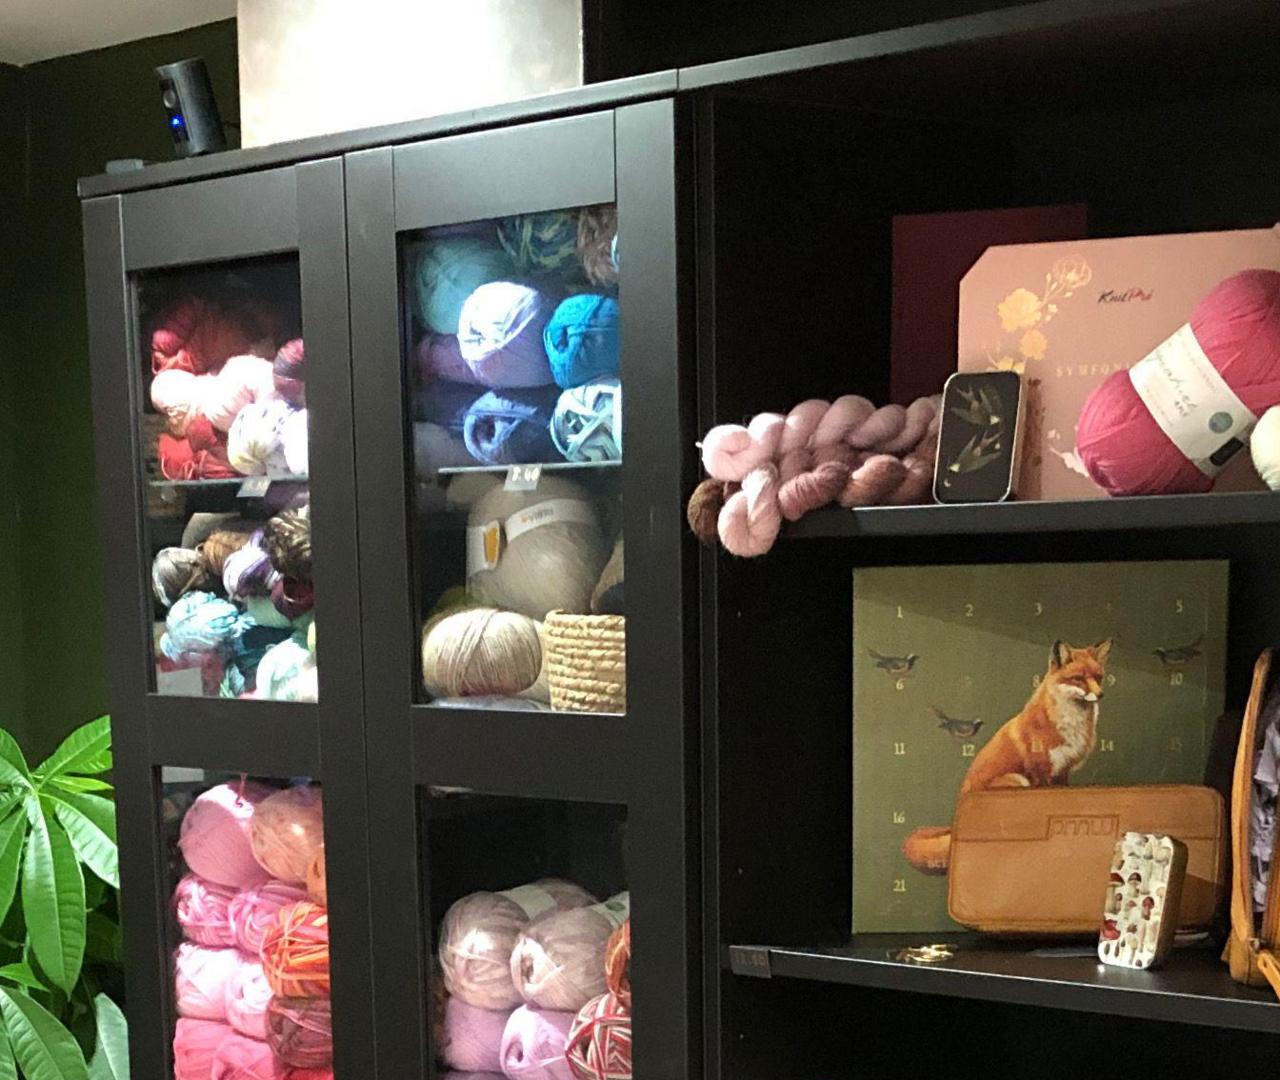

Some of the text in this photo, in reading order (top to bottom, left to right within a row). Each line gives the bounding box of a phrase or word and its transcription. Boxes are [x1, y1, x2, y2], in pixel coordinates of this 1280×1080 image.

[897, 606, 904, 618] 1
[966, 604, 974, 617] 2
[1035, 603, 1043, 615] 3
[1176, 599, 1184, 613] 5
[896, 678, 904, 691] 6
[1107, 674, 1116, 686] 9
[1170, 673, 1183, 686] 10
[894, 742, 906, 756] 11
[962, 744, 975, 757] 12
[1100, 738, 1114, 752] 14
[893, 811, 906, 824] 16
[893, 879, 907, 893] 21
